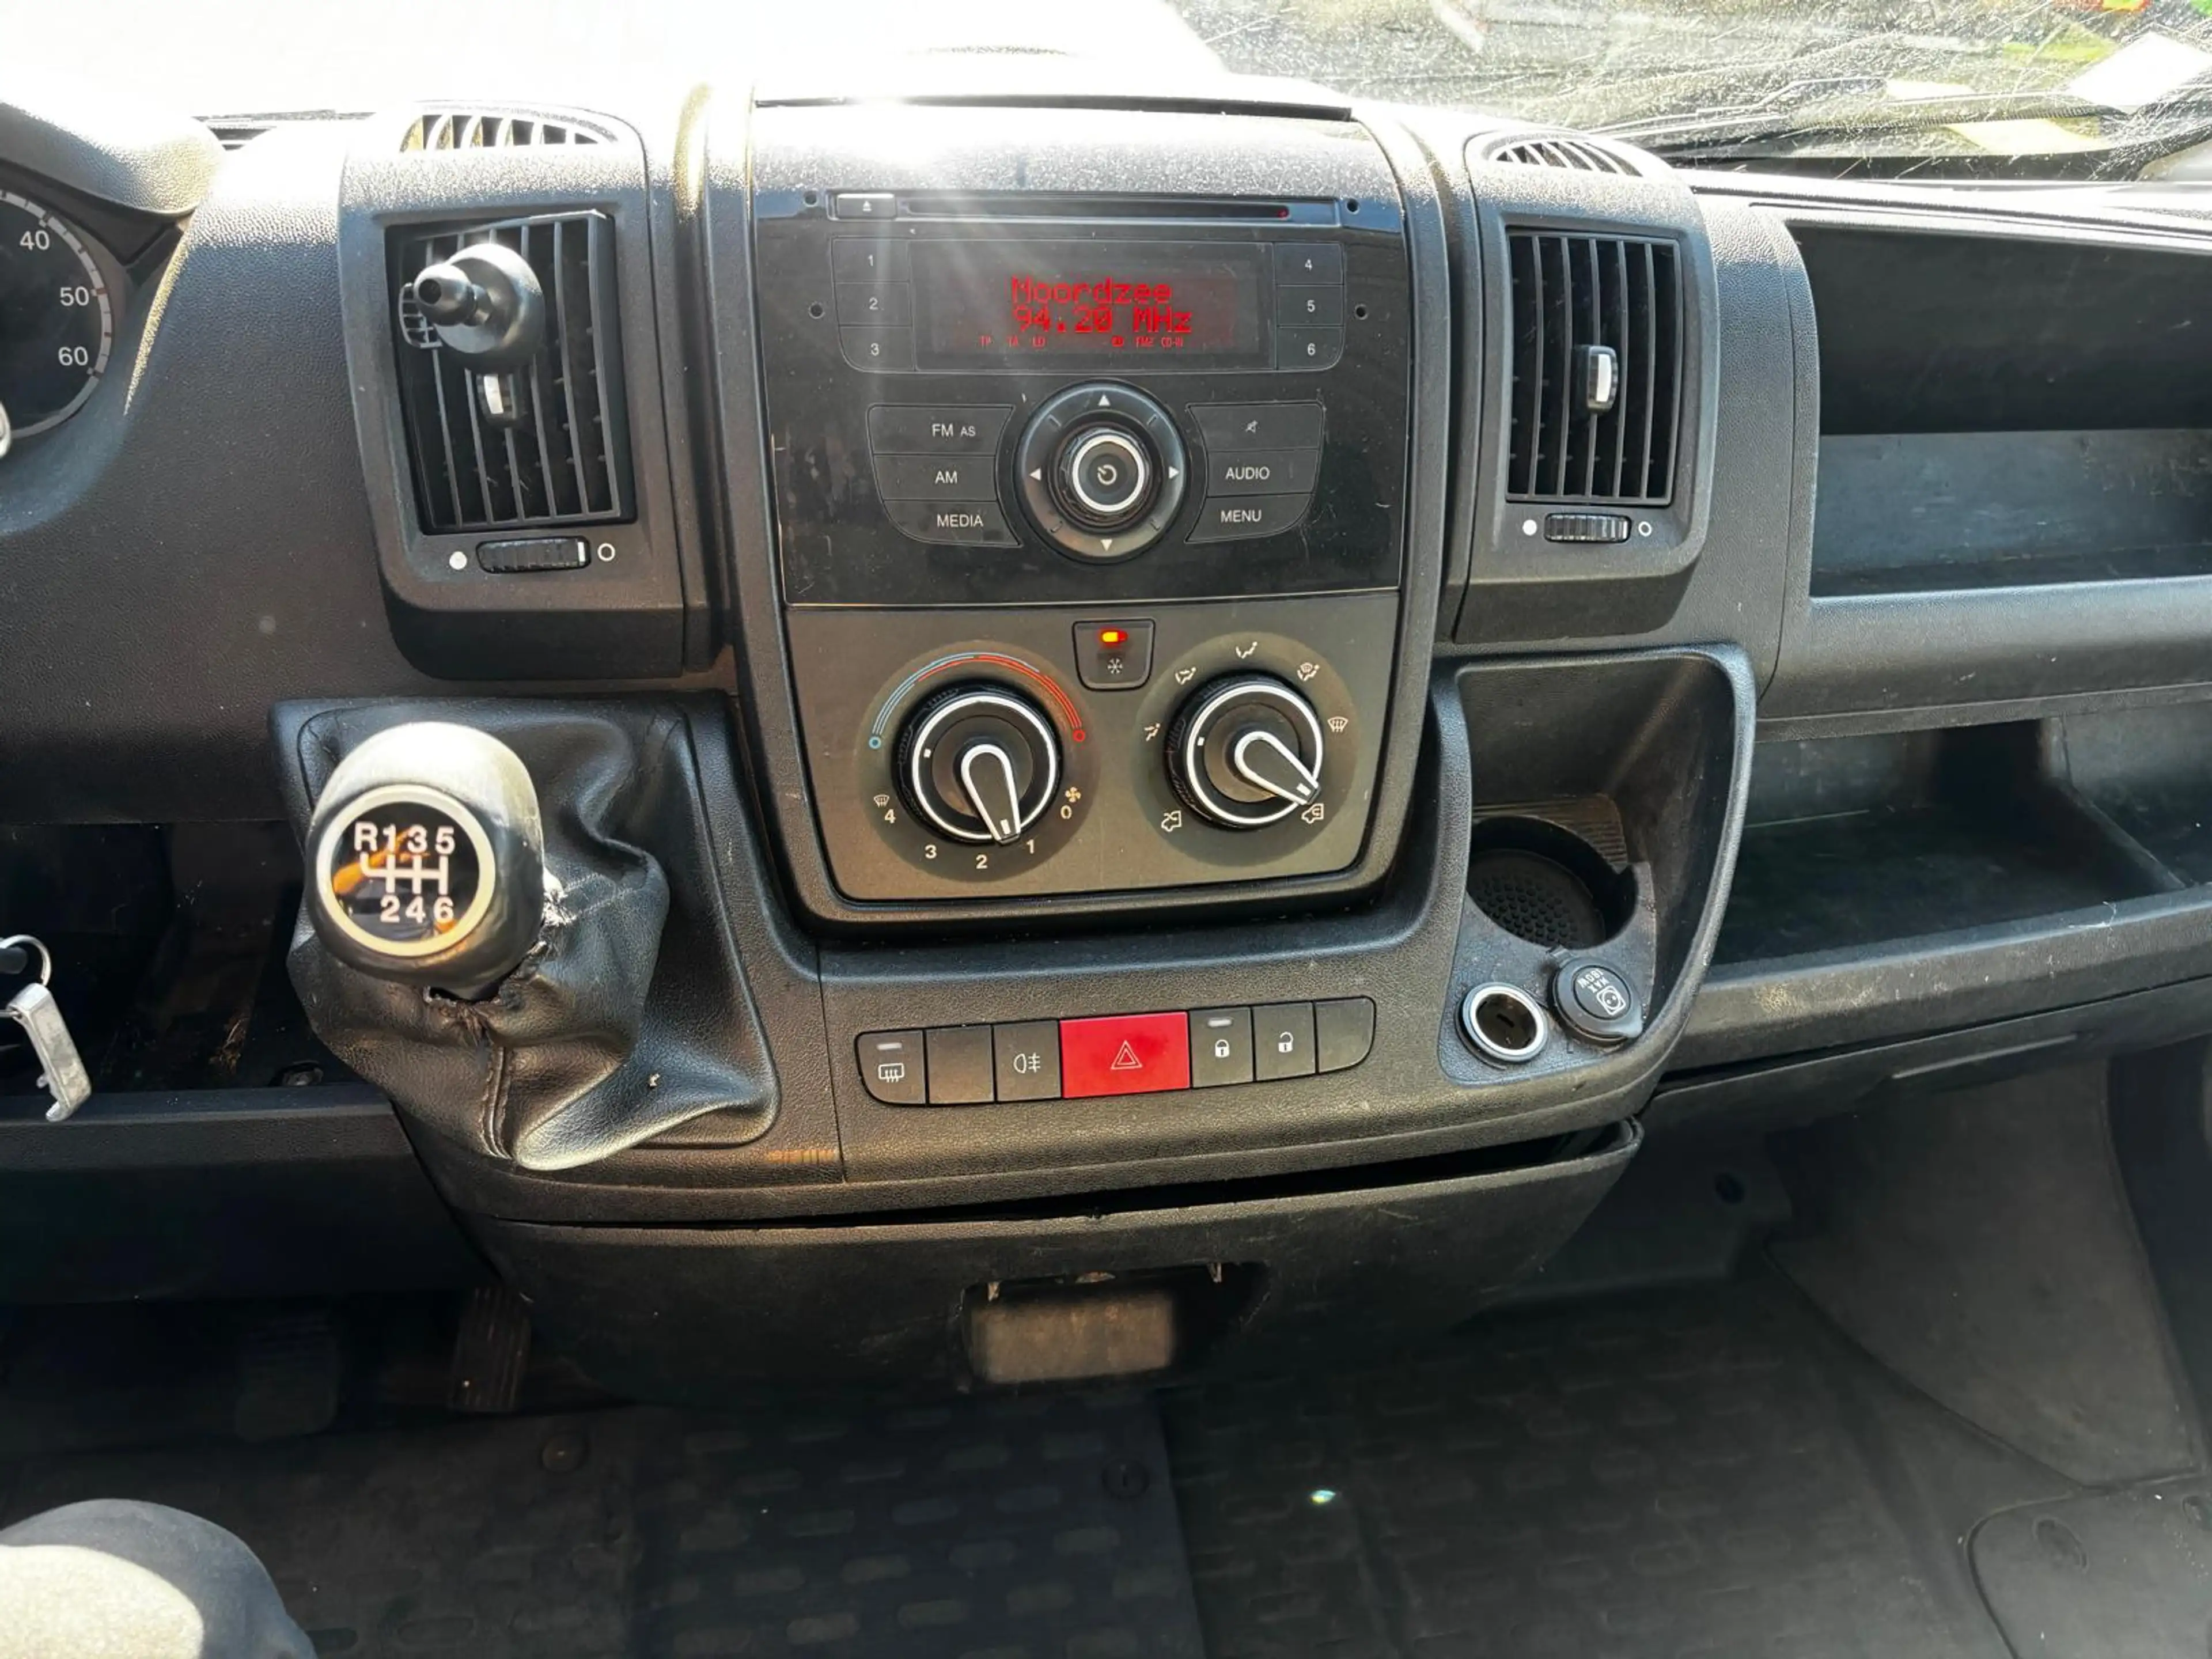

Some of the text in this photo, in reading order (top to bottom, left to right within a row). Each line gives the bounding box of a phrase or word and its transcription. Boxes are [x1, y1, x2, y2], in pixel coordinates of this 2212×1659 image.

[20, 230, 50, 251] 40
[868, 254, 874, 267] 1
[1304, 259, 1313, 272] 4
[59, 286, 90, 306] 50
[869, 297, 879, 310] 2
[1306, 300, 1316, 312] 5
[1013, 305, 1193, 333] 94.20 MHz
[58, 346, 89, 365] 60
[870, 342, 880, 356] 3
[1307, 343, 1316, 356] 6
[931, 423, 976, 438] FM AS
[934, 470, 958, 484] AM
[1225, 465, 1270, 480] AUDIO
[937, 513, 984, 528] MEDIA
[1220, 509, 1262, 524] MENU
[884, 808, 897, 824] 4
[1060, 805, 1073, 820] 0
[354, 821, 456, 855] R 1 3 5
[925, 844, 938, 859] 3
[1026, 839, 1036, 854] 1
[975, 854, 988, 870] 2
[380, 894, 454, 924] 2 4 6
